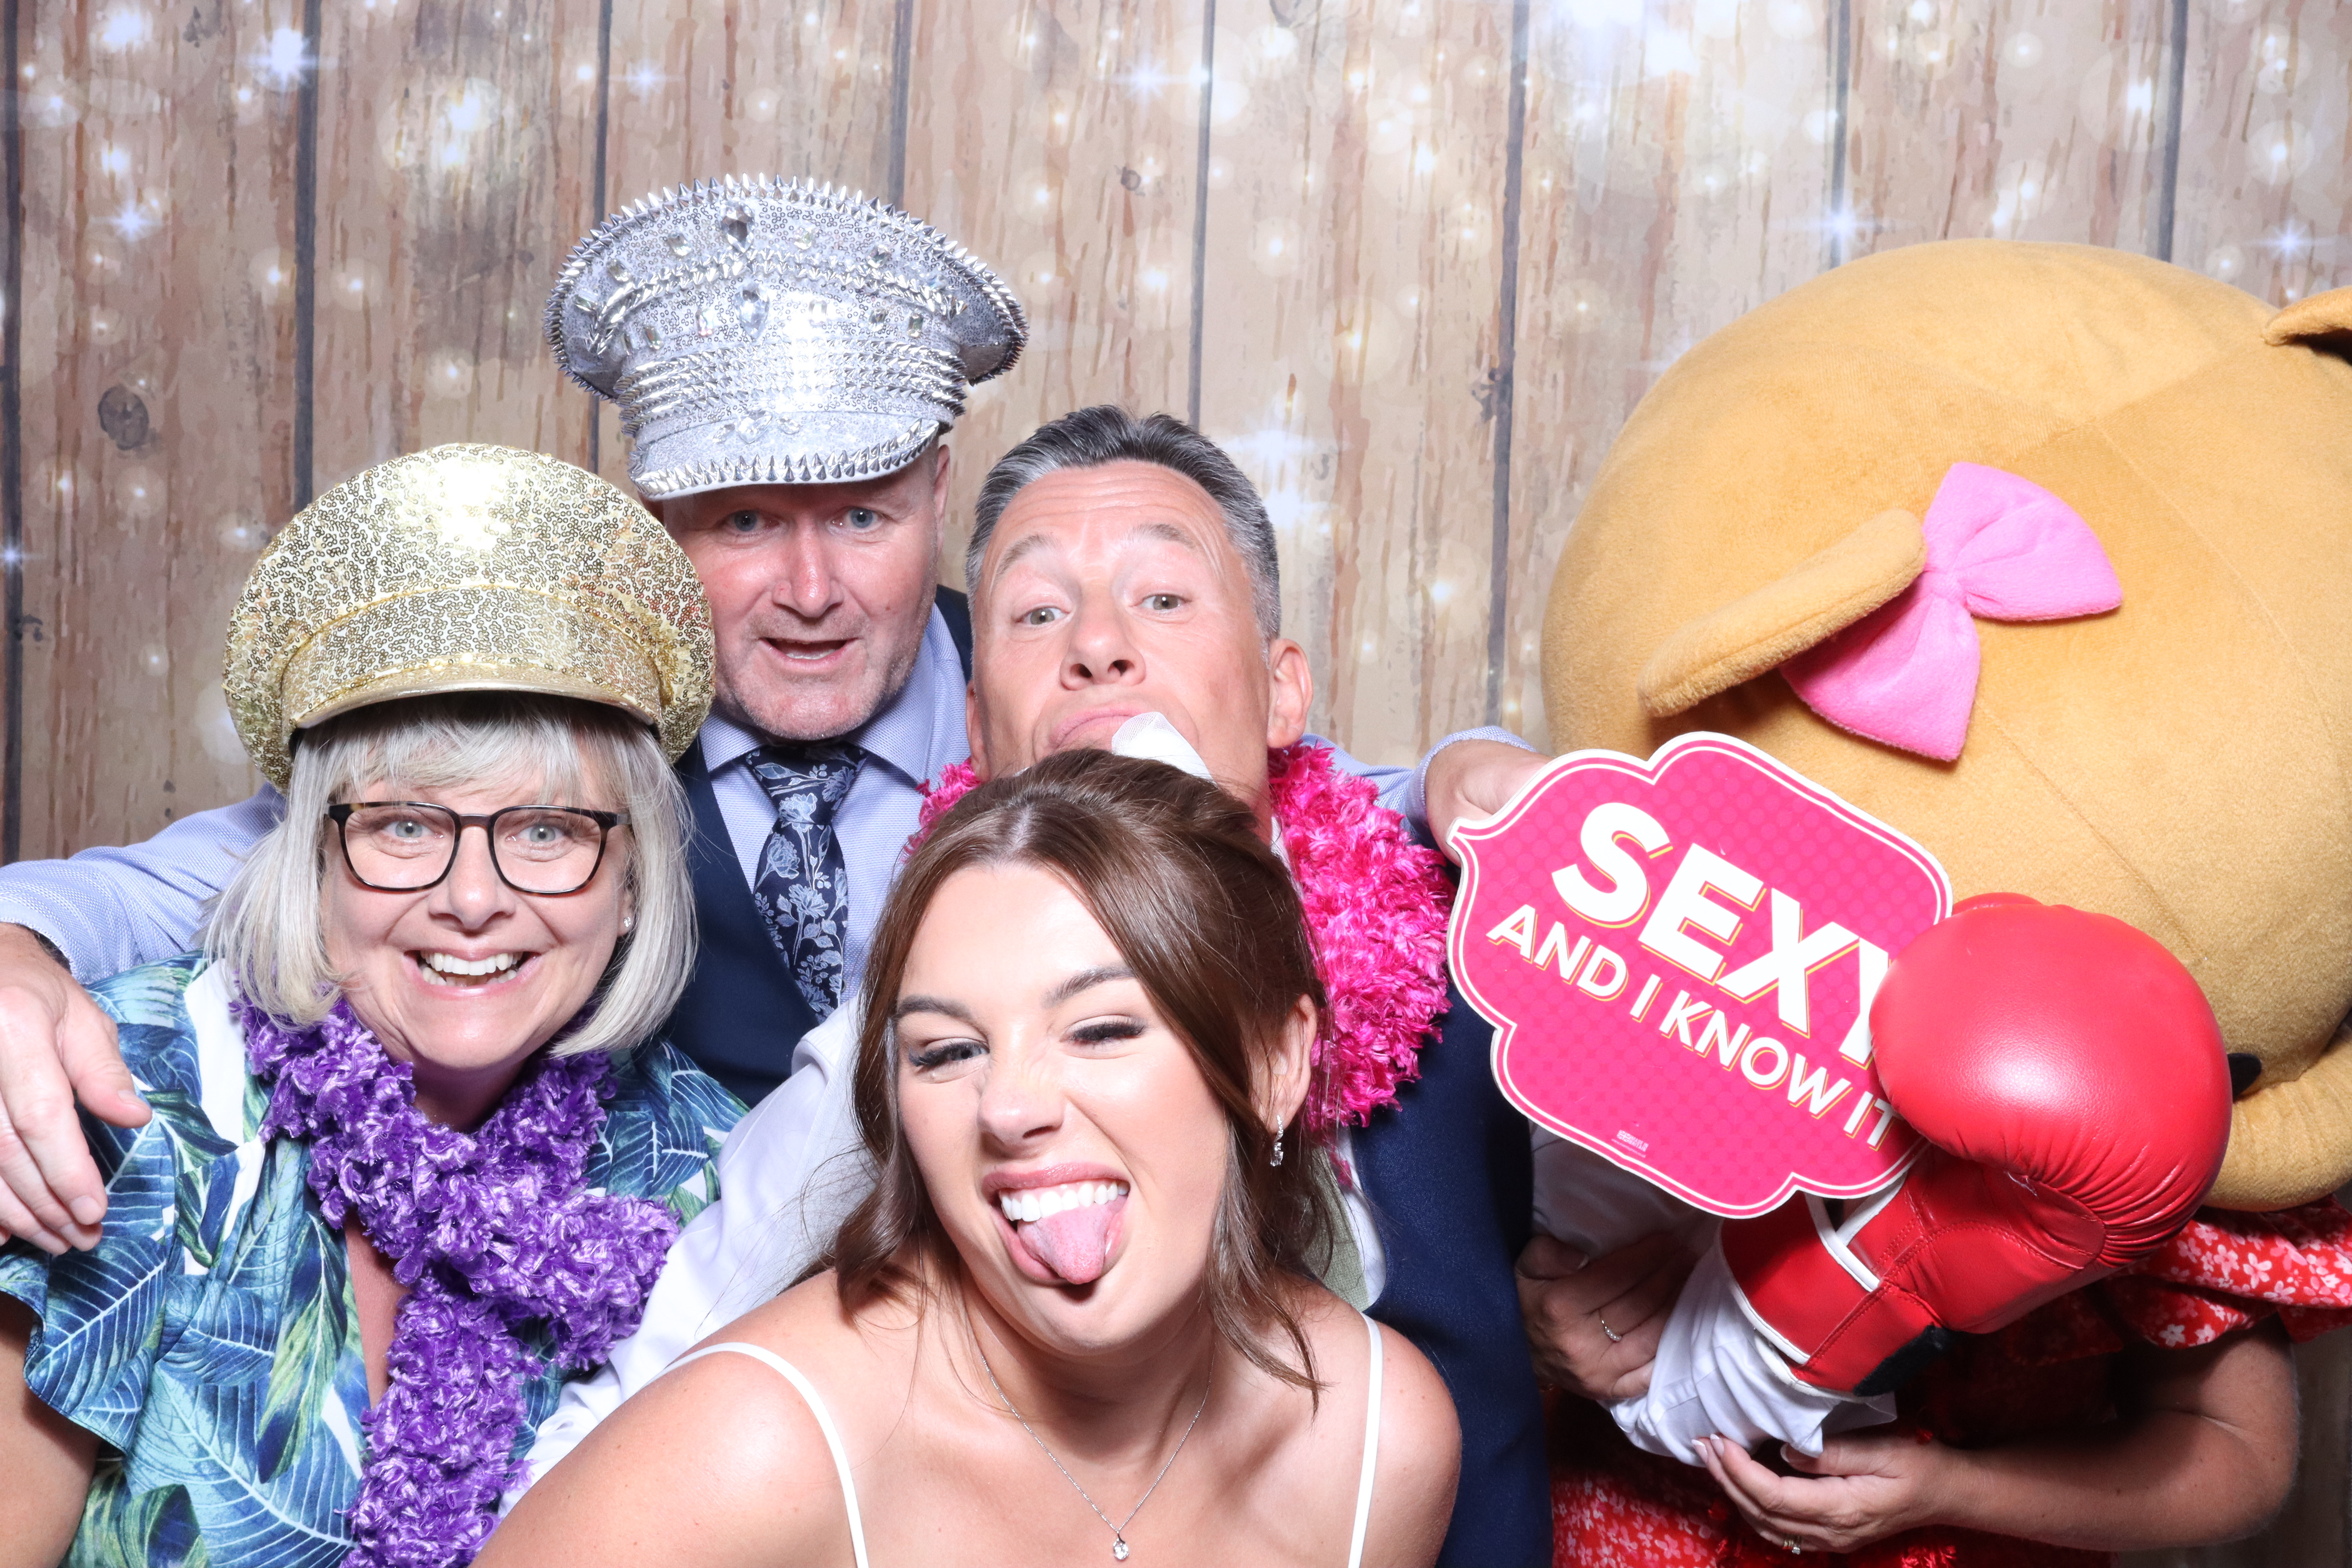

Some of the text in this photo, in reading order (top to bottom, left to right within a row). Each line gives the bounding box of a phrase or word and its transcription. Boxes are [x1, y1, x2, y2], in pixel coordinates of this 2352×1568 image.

[1552, 802, 1891, 1067] SEXY
[1486, 904, 1904, 1149] AND I KNOW IT
[1628, 1140, 1646, 1152] BRITAIN
[1630, 1135, 1644, 1145] MADE
